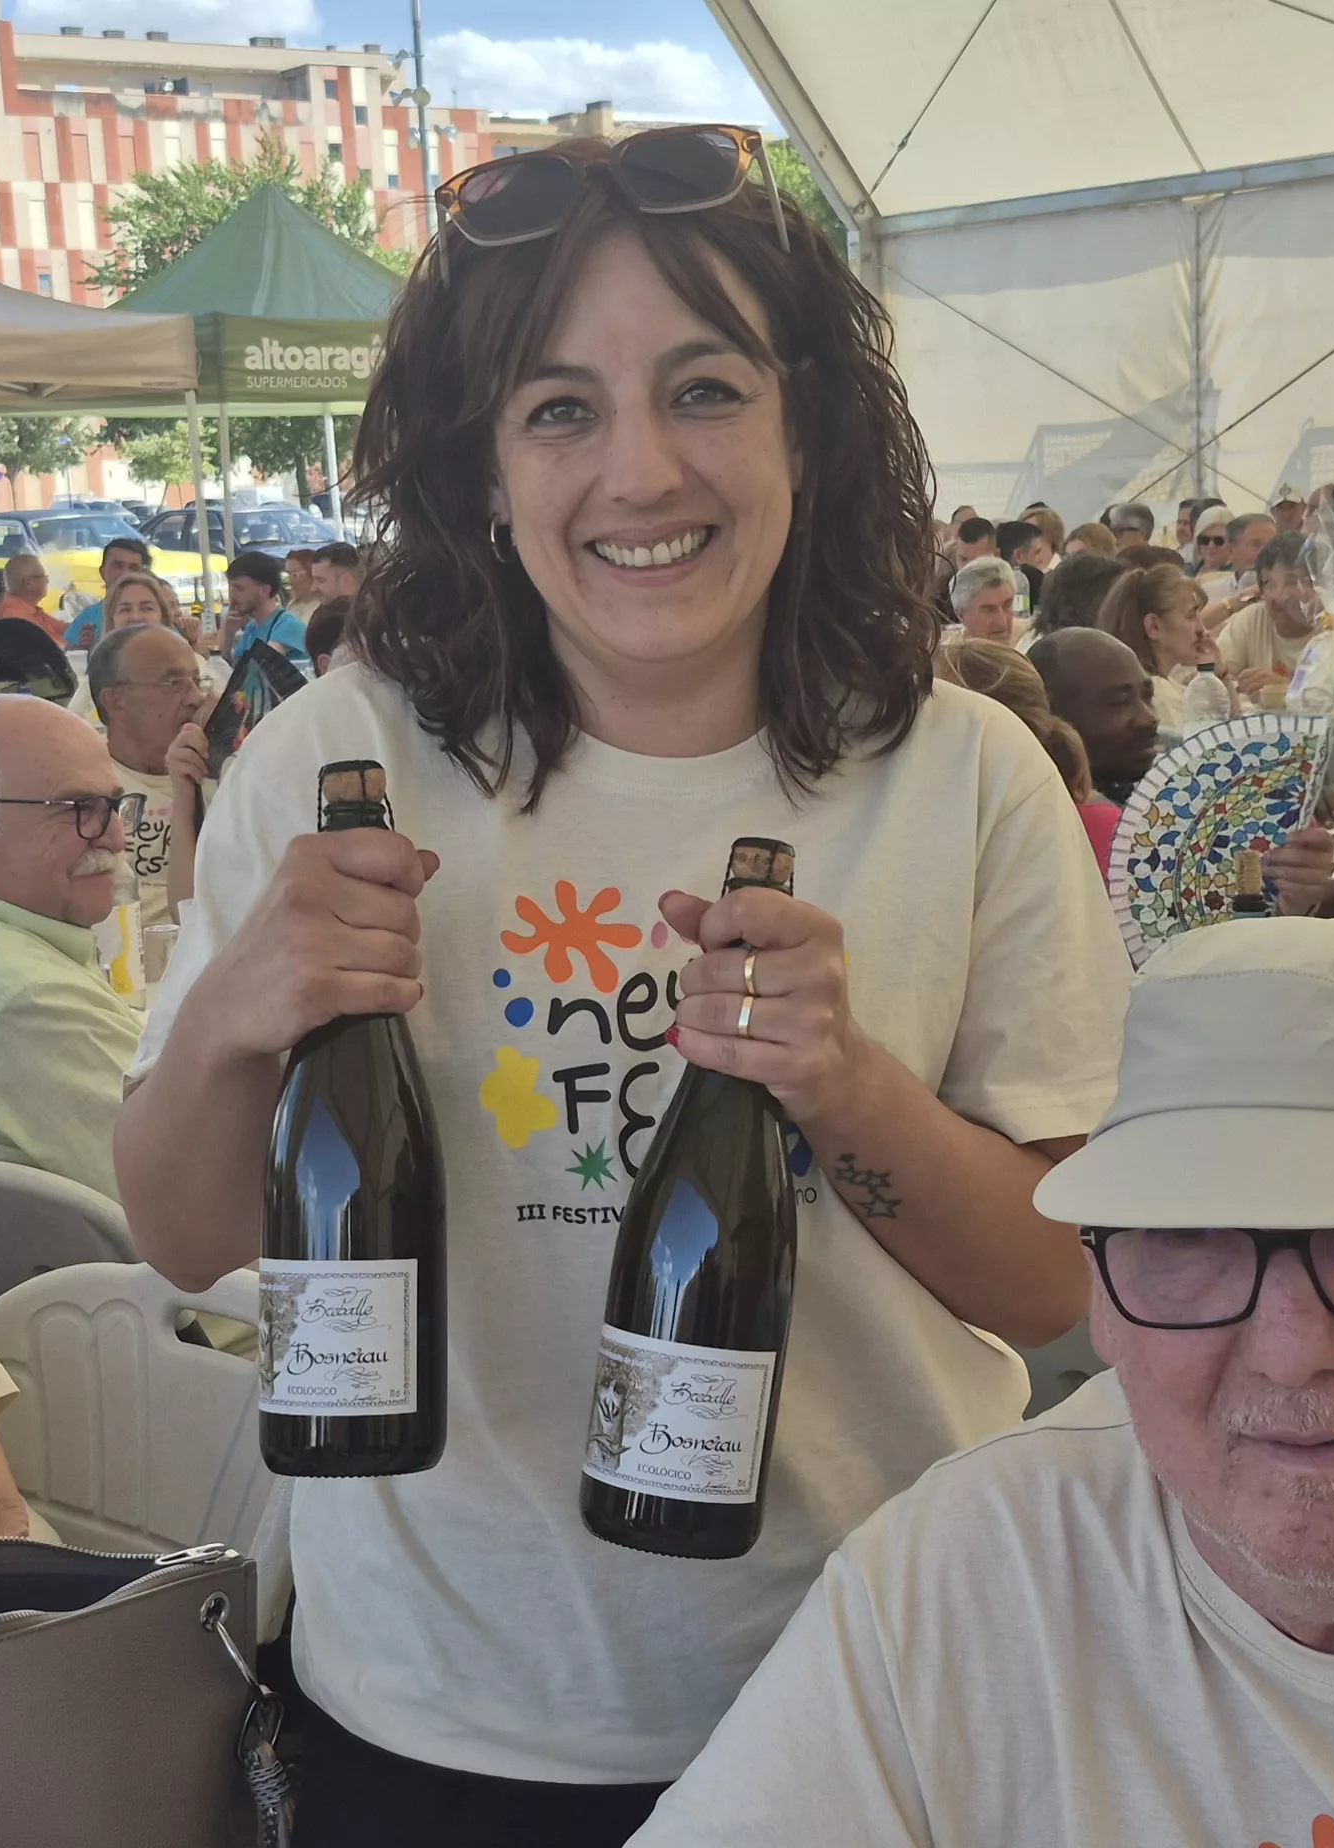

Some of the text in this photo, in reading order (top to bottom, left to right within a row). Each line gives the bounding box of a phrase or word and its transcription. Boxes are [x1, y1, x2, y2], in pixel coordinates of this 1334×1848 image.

[244, 335, 387, 379] altoaragó
[247, 376, 348, 388] SUPERMERCADOS
[517, 1204, 546, 1222] III
